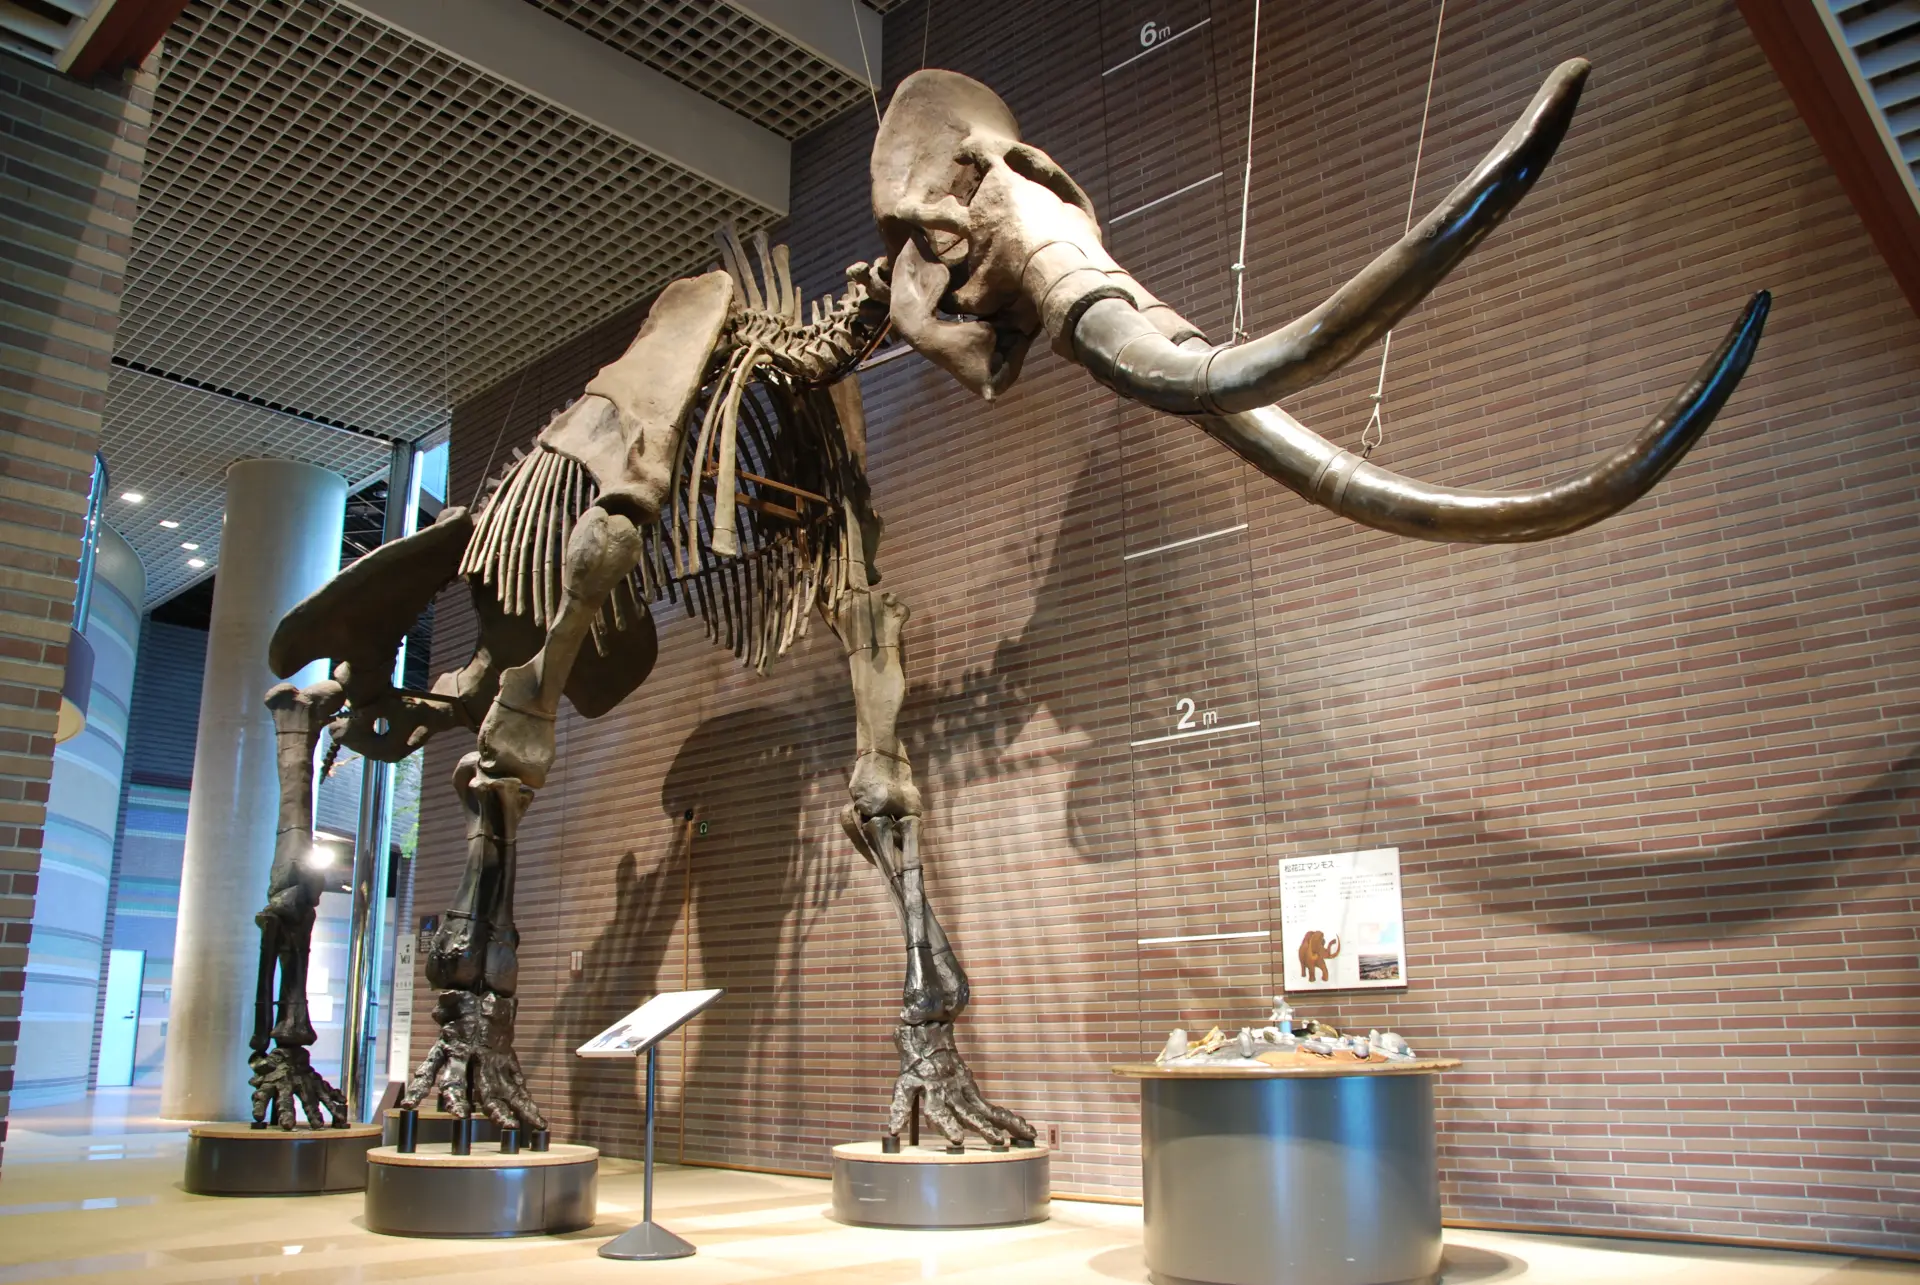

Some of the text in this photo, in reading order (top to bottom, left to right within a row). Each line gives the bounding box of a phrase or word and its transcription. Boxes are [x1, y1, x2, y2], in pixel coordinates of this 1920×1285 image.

[1284, 860, 1334, 873] 松花江マンモス
